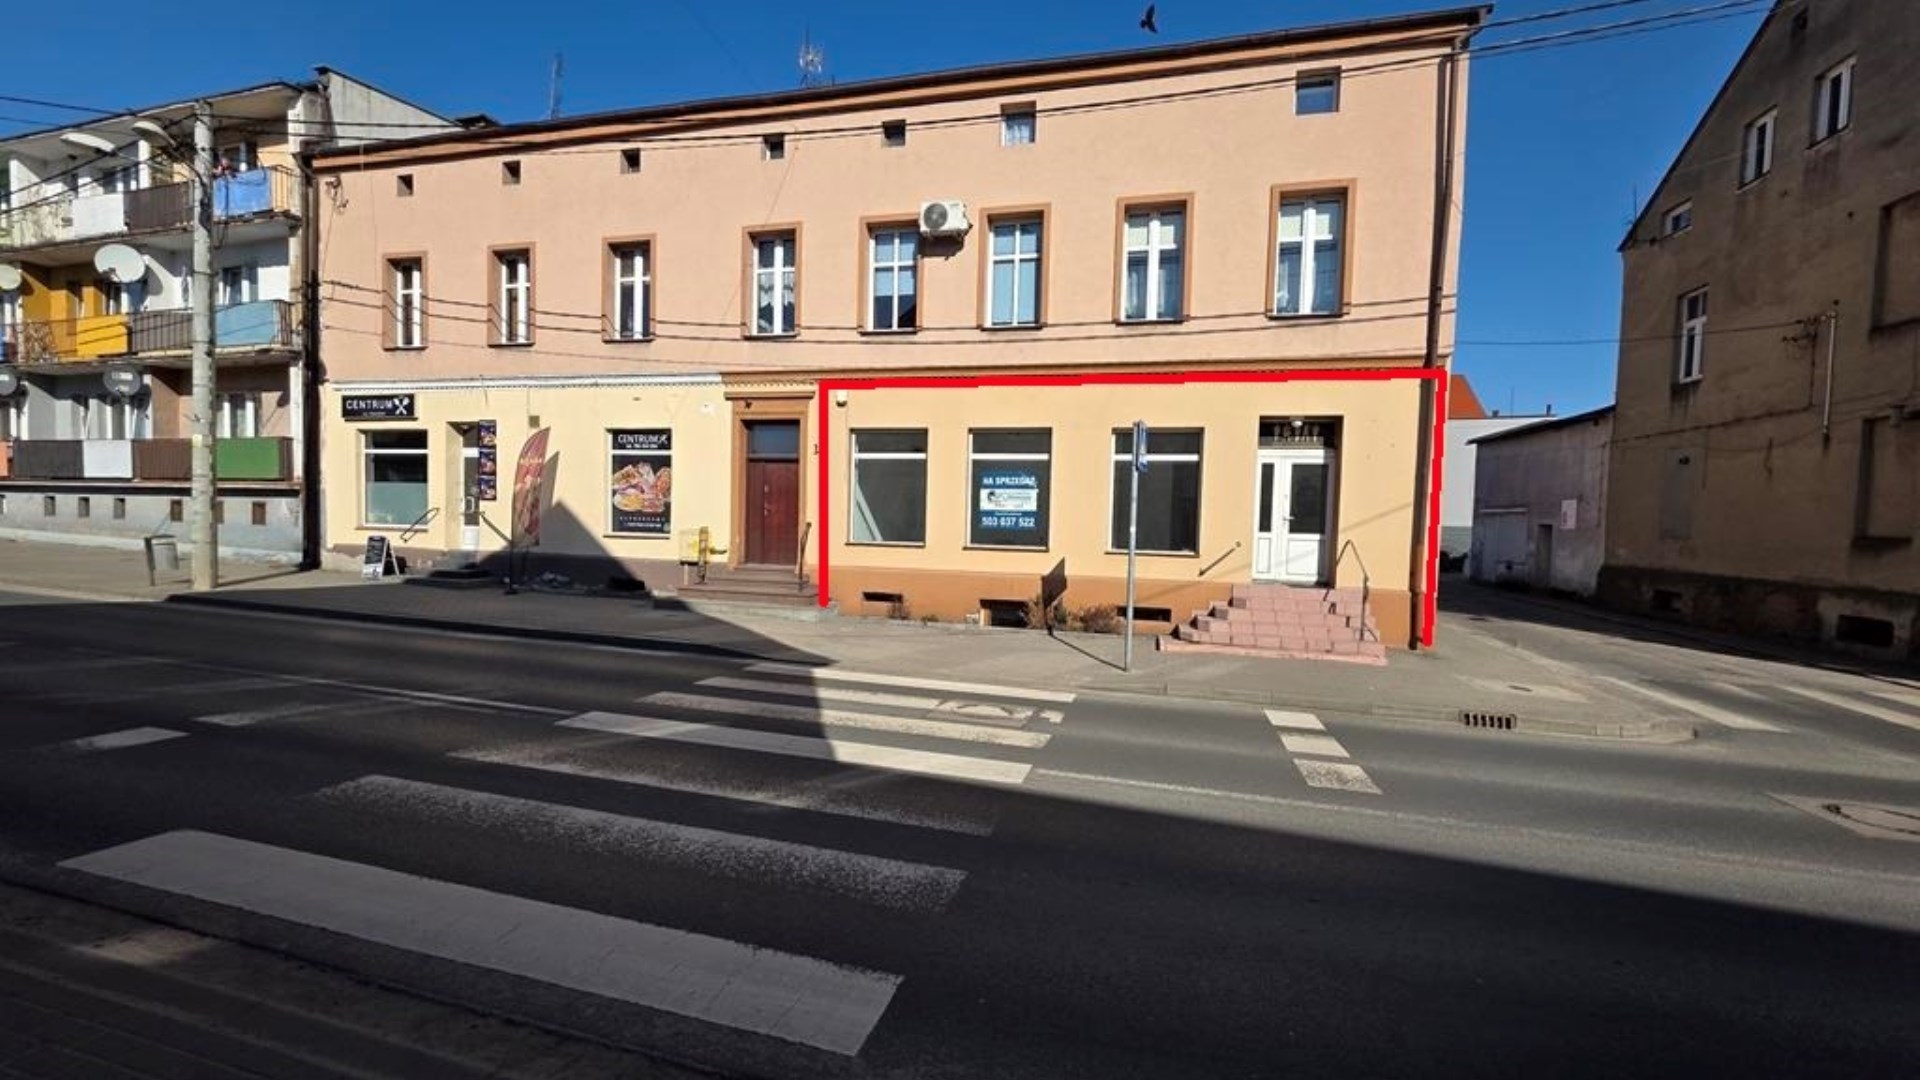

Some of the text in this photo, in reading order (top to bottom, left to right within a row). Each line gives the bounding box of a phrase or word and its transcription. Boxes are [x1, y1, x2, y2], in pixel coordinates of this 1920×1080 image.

[346, 399, 392, 409] CENTRUM
[618, 434, 659, 443] CENTRUM
[983, 477, 994, 486] NA
[1019, 517, 1036, 527] 522
